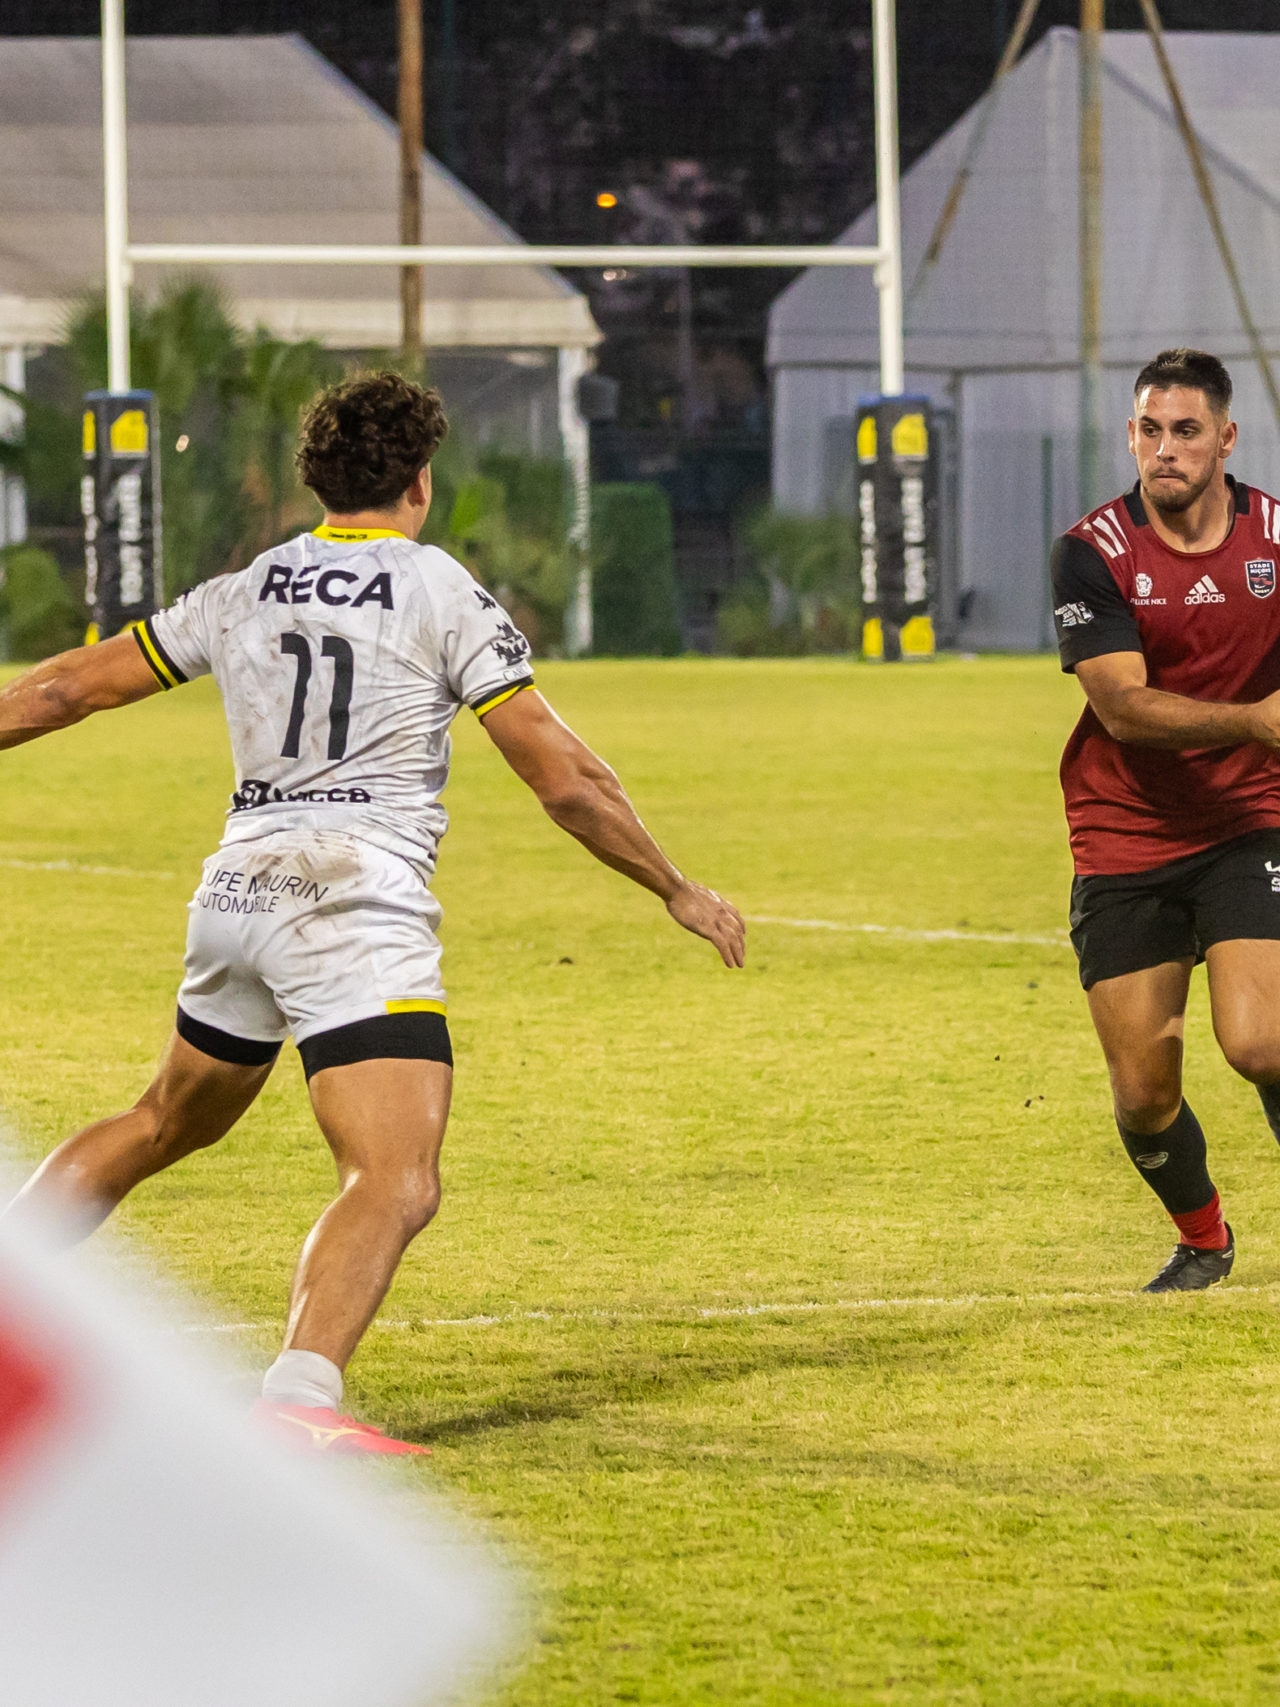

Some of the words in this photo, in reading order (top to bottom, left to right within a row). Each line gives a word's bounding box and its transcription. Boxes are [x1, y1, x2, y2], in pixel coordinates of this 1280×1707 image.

[258, 564, 395, 611] RECA
[1184, 593, 1226, 606] adidas
[280, 632, 354, 761] 11
